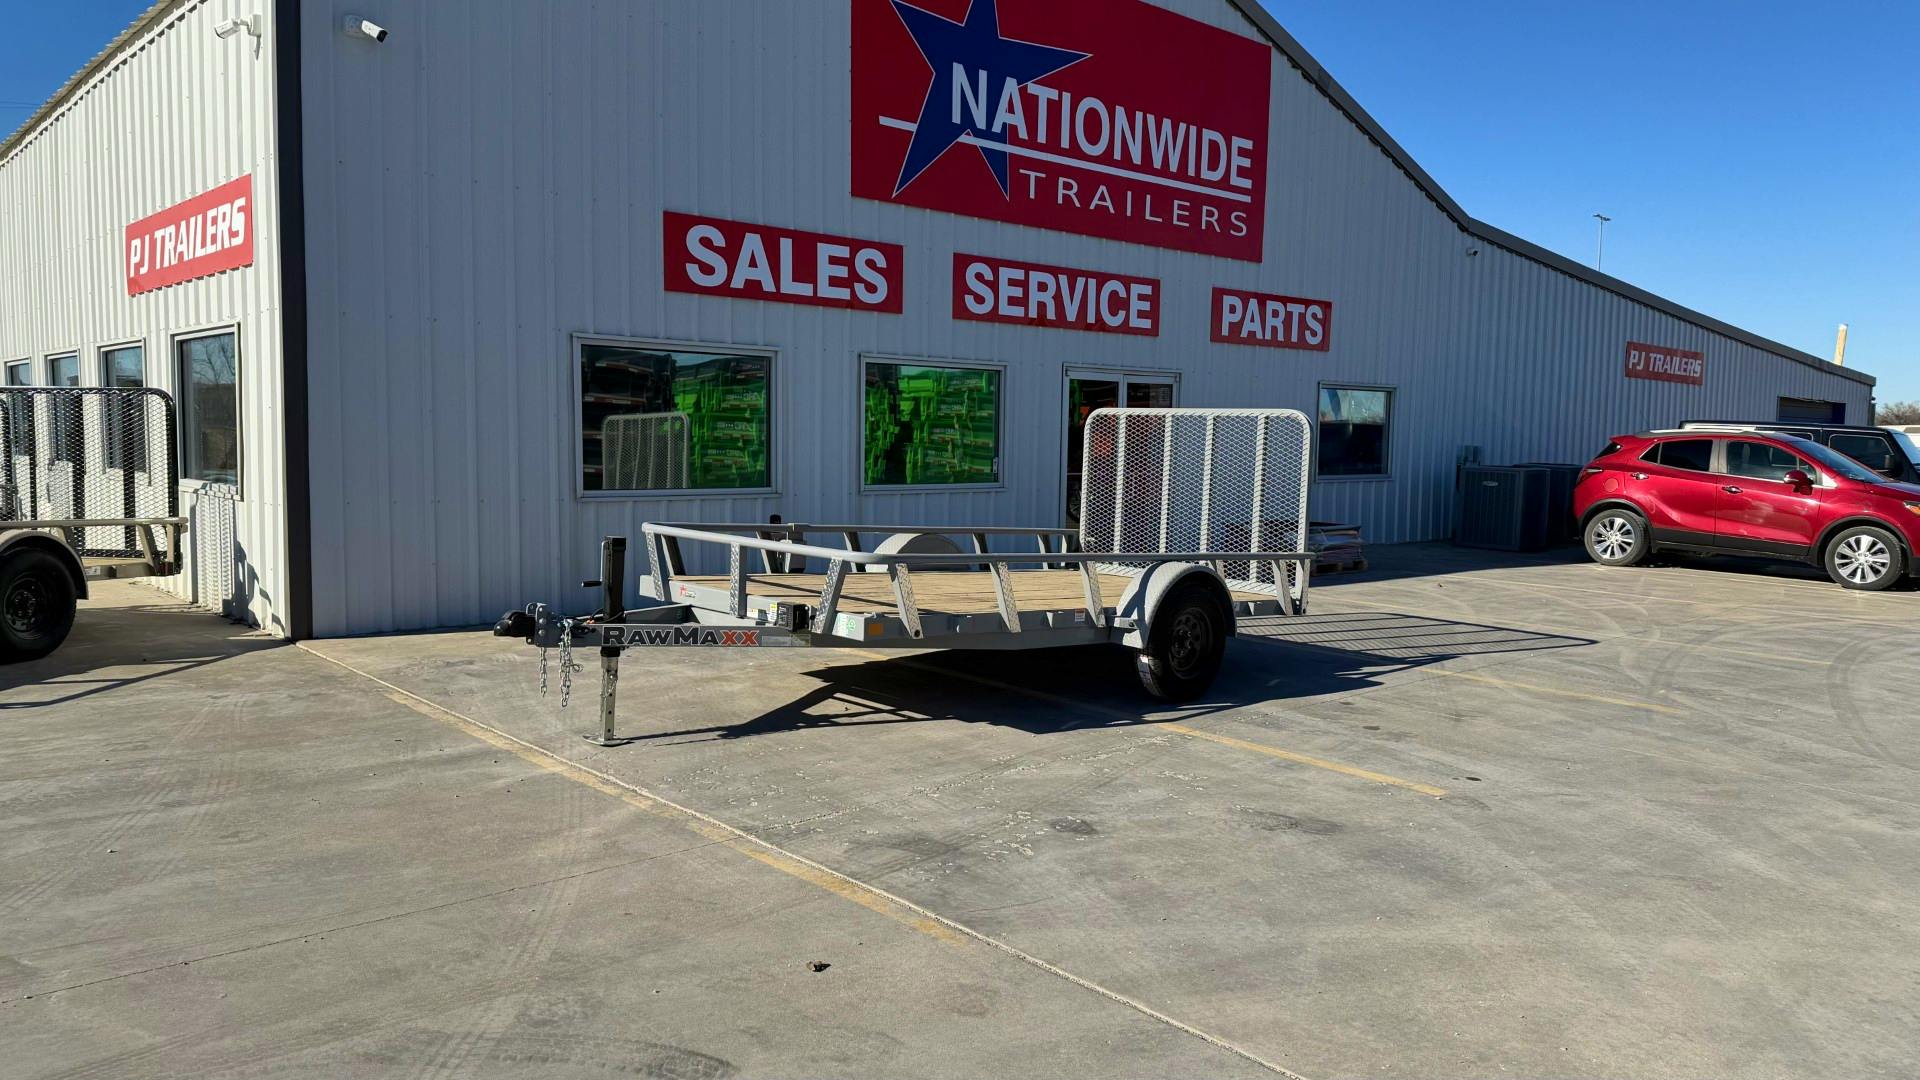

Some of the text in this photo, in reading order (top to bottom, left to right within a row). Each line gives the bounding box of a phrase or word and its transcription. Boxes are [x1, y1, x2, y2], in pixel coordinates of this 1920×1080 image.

[951, 61, 1254, 190] NATIONWIDE
[129, 196, 247, 278] PJ TRAILERS
[1019, 168, 1249, 238] TRAILERS
[684, 224, 889, 305] SALES
[963, 262, 1153, 330] SERVICE
[1220, 296, 1324, 346] PARTS
[1628, 350, 1702, 376] PJ TRAILERS
[602, 626, 760, 647] RAWMAXX
